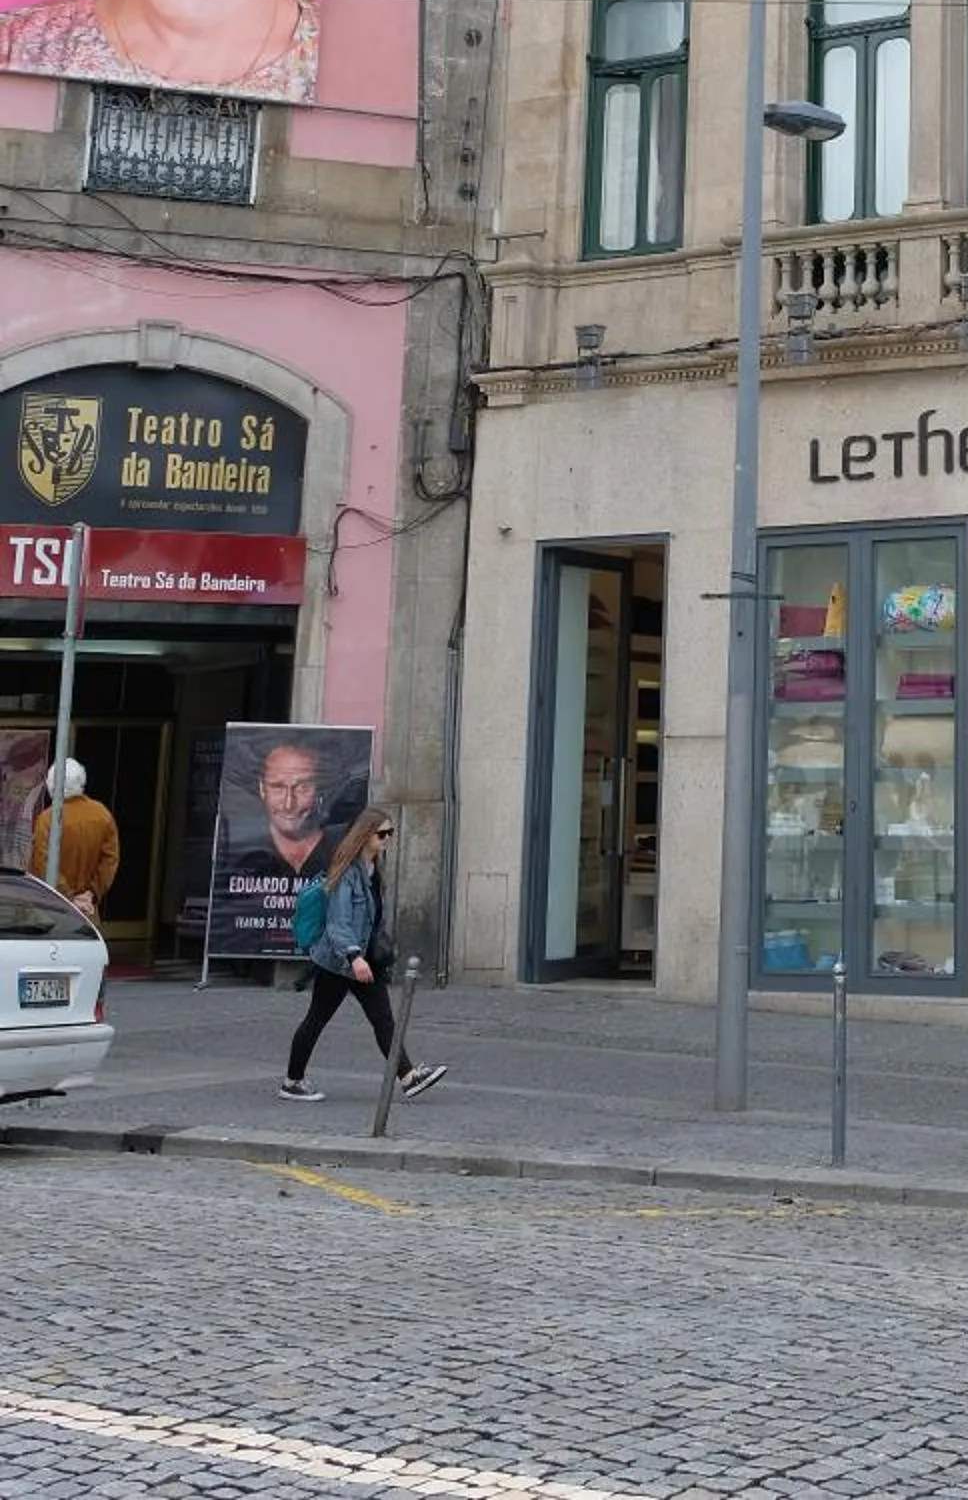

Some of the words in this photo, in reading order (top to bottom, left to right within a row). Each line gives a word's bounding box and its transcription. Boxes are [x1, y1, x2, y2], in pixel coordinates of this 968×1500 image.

[127, 406, 222, 448] Teatro
[240, 414, 275, 451] Sá
[121, 451, 150, 488] da
[165, 452, 271, 494] Bandeira
[101, 569, 151, 589] Teatro
[155, 571, 173, 589] Sá
[178, 572, 197, 590] da
[200, 572, 265, 593] Bandeira
[229, 876, 289, 894] EDUARDO
